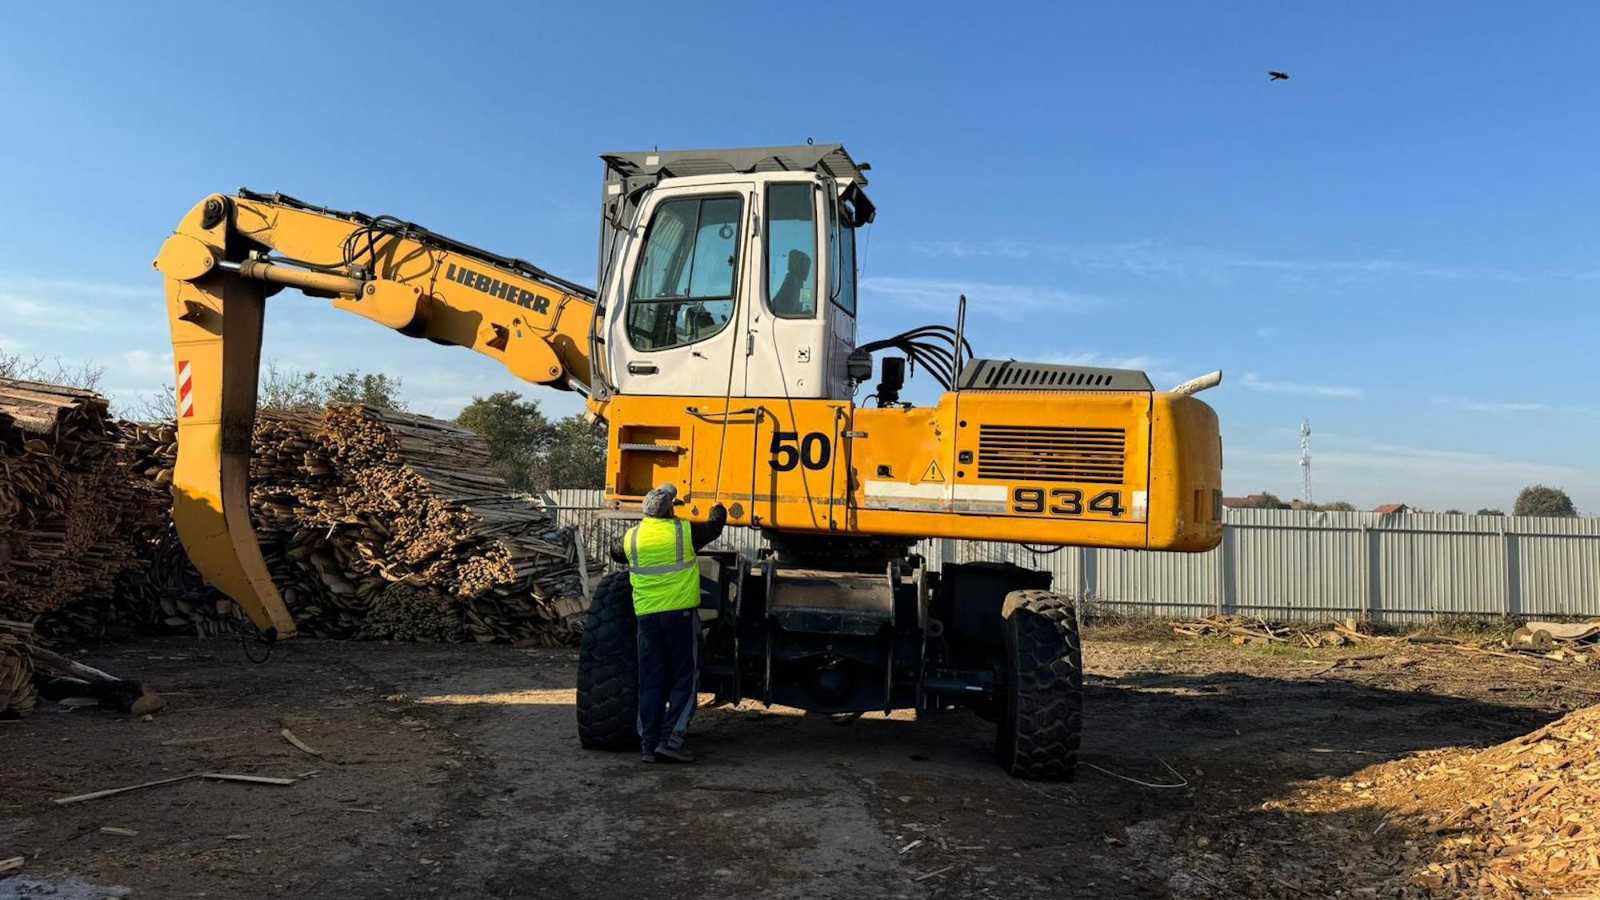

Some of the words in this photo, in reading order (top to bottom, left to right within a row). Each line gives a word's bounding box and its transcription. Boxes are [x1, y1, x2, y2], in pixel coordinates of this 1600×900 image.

[446, 263, 551, 315] LIEBHERR
[768, 431, 831, 472] 50
[1012, 487, 1127, 516] 934
